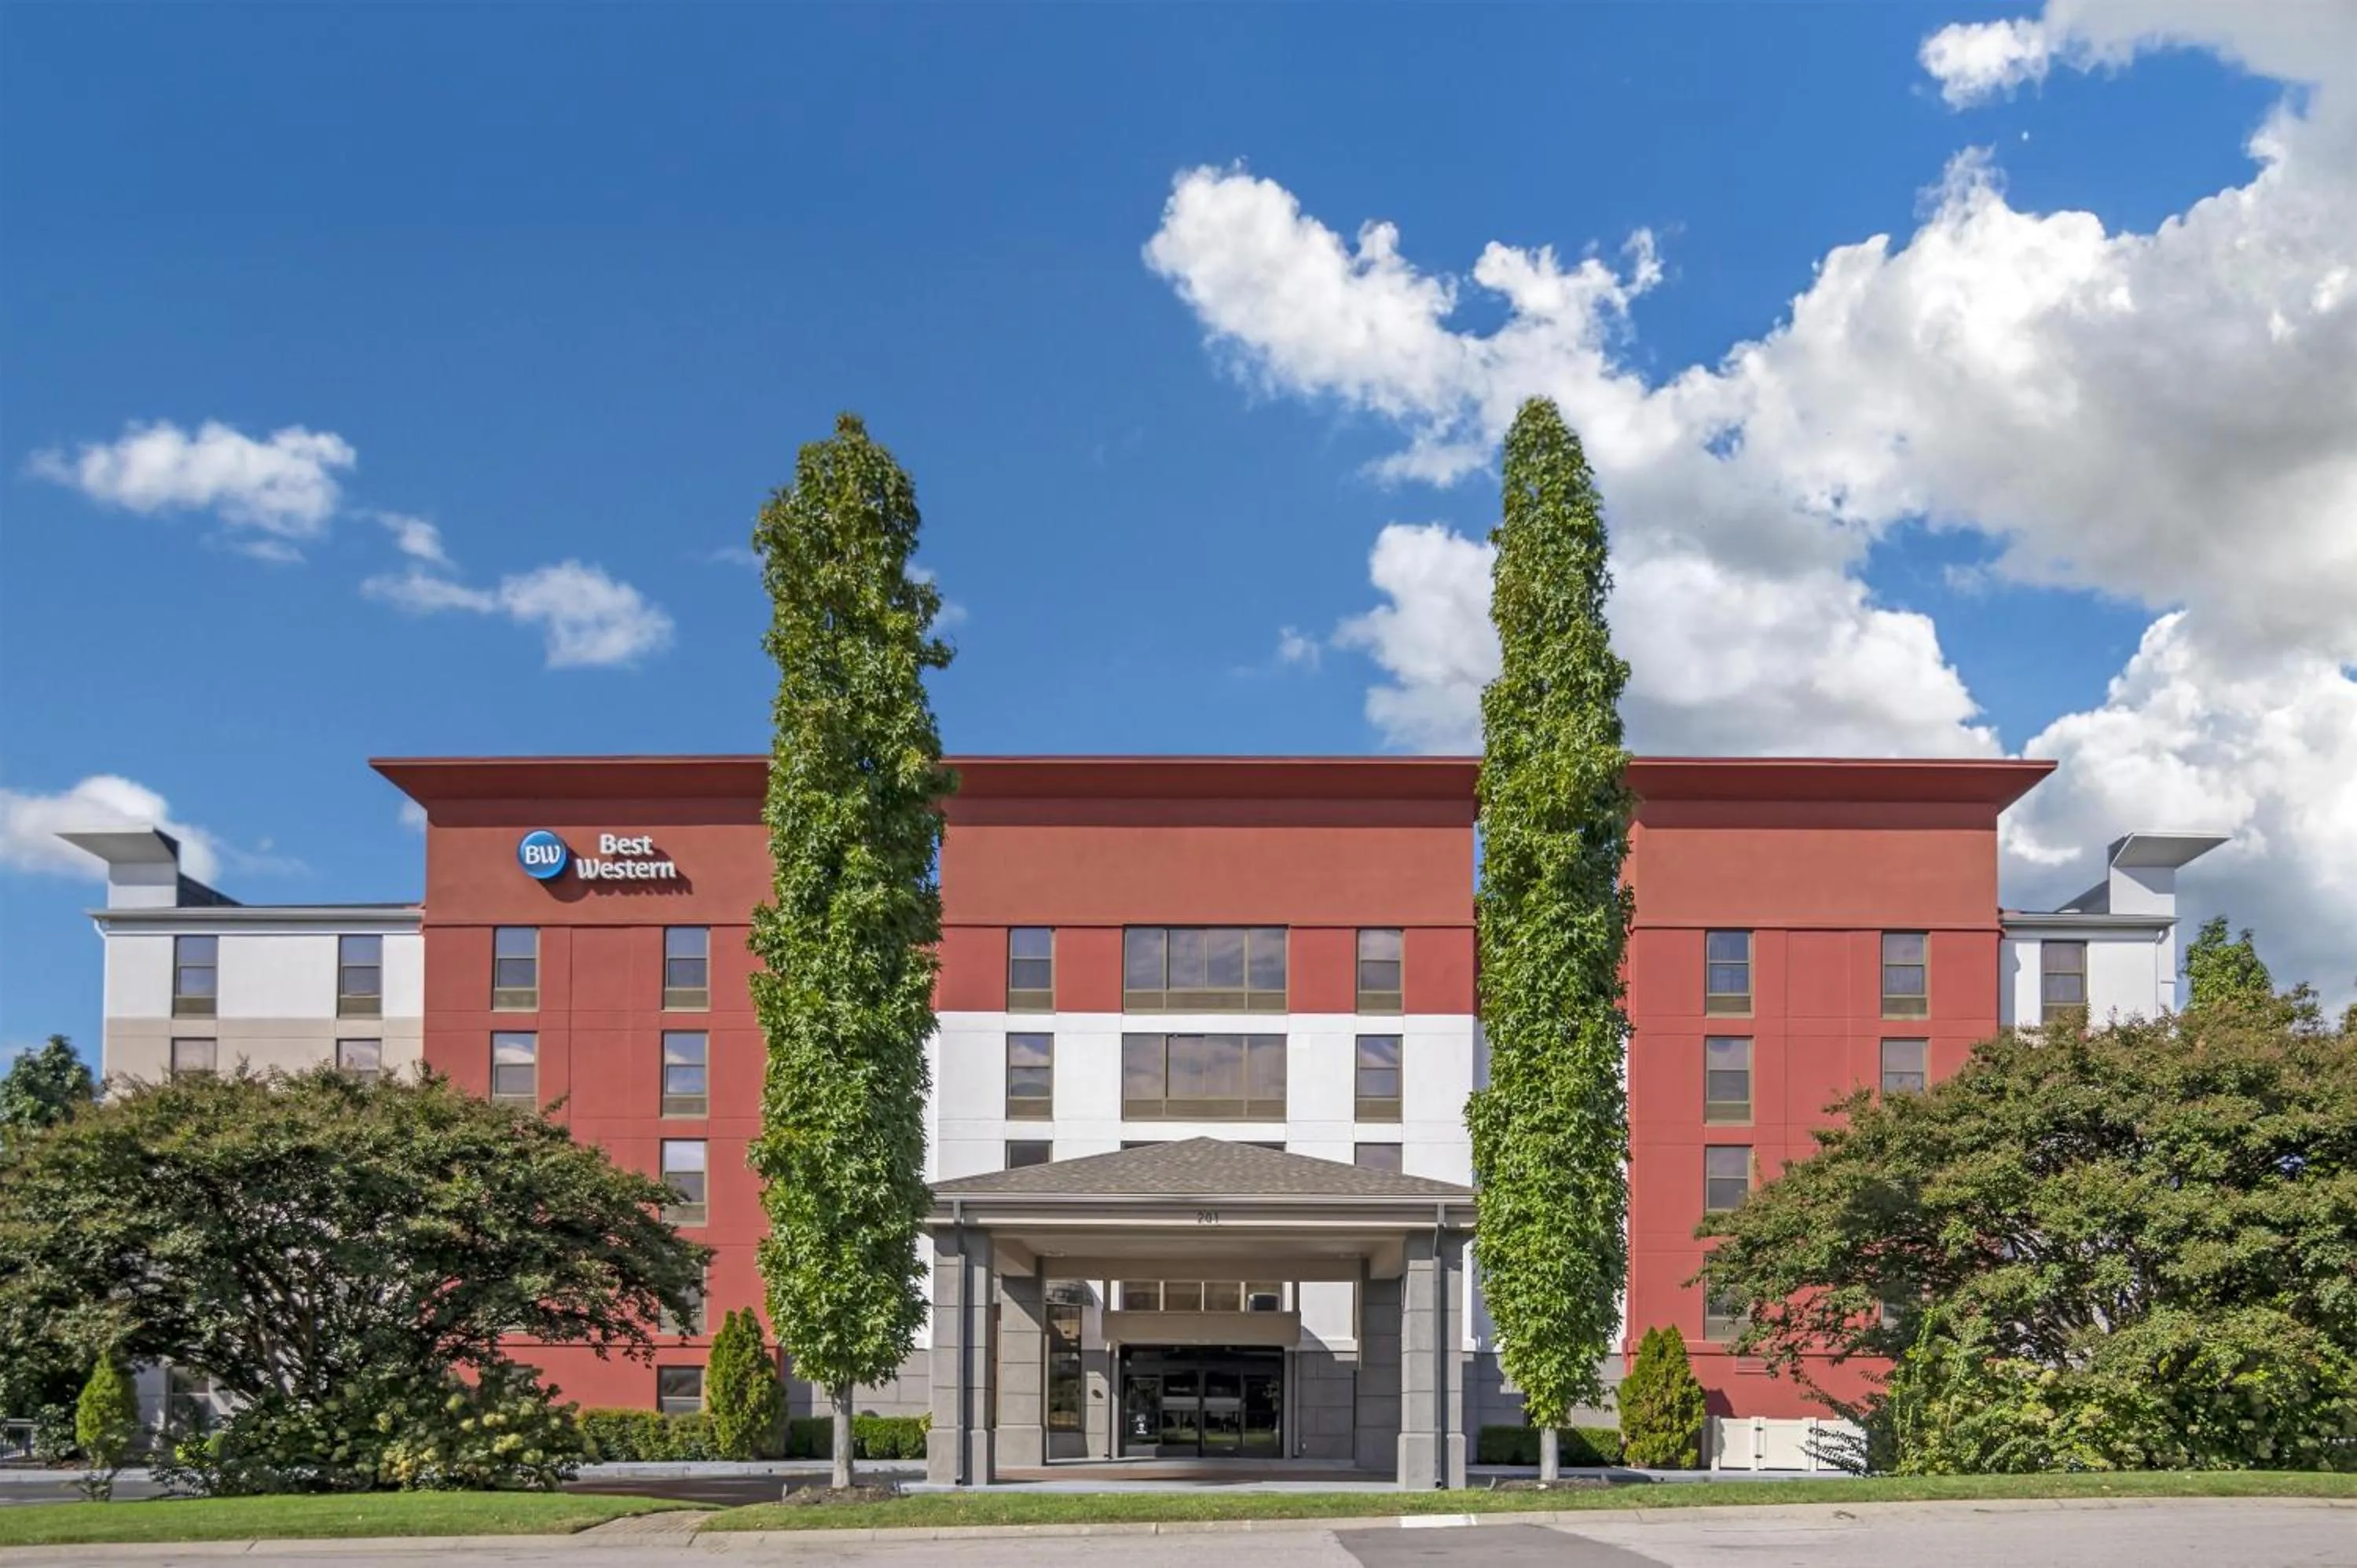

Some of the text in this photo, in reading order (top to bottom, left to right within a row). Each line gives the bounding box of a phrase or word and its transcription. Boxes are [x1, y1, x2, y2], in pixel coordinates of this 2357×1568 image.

[525, 844, 560, 865] BW
[599, 833, 654, 855] Best
[576, 859, 676, 881] Western
